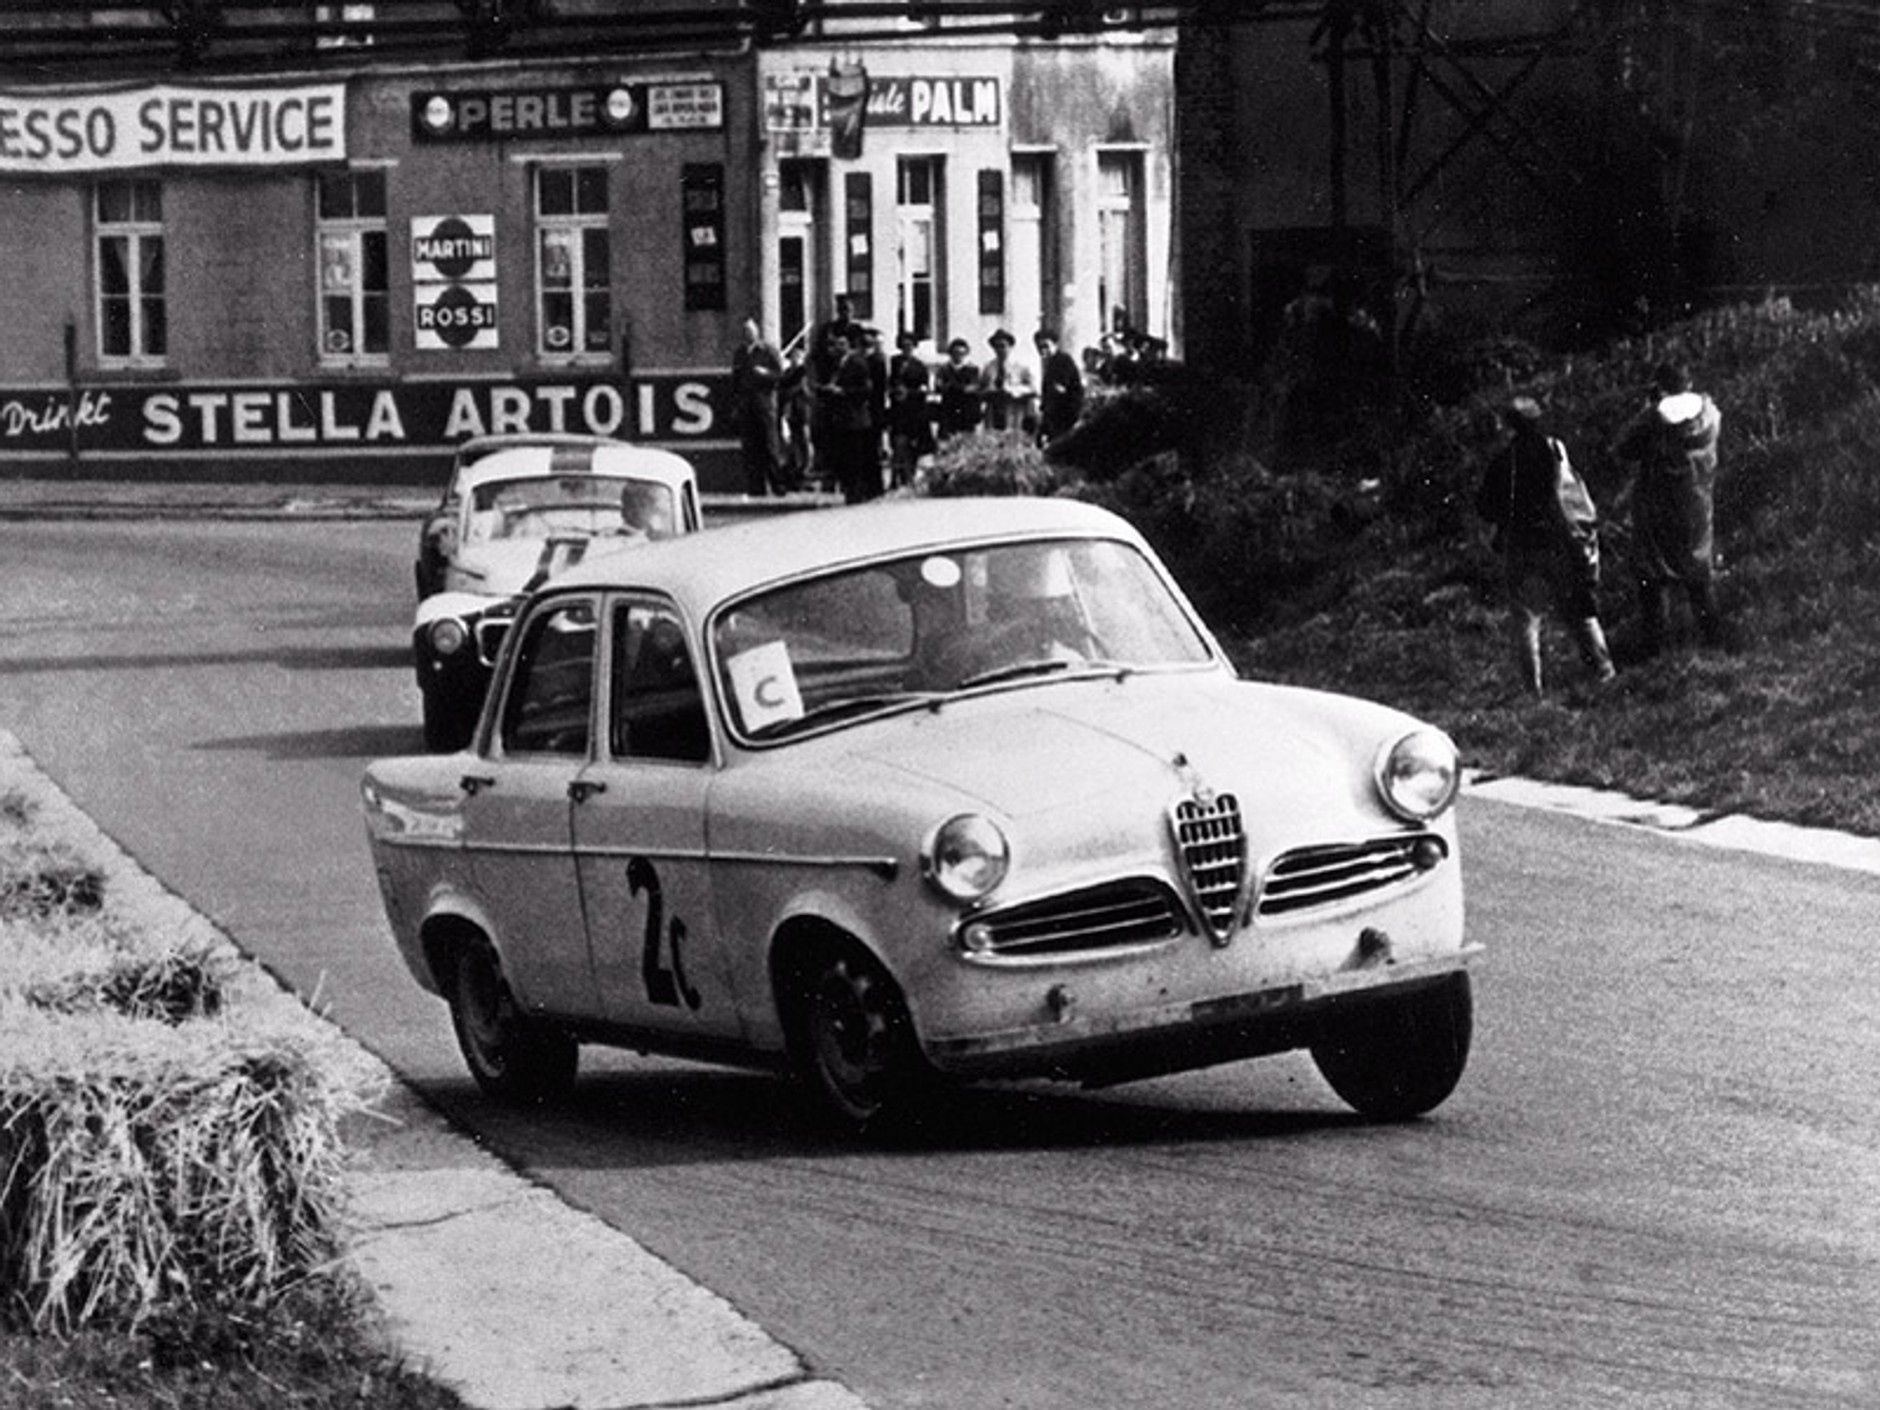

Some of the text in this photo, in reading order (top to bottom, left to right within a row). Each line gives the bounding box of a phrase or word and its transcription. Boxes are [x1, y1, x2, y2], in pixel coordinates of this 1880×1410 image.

[457, 93, 597, 132] PERLE
[911, 79, 997, 123] PALM
[0, 95, 334, 159] ESSO SERVICE
[416, 239, 492, 260] MARTINI
[420, 306, 493, 327] ROSSI
[142, 390, 405, 443] STELLA
[444, 382, 713, 438] ARTOIS
[754, 675, 786, 708] C
